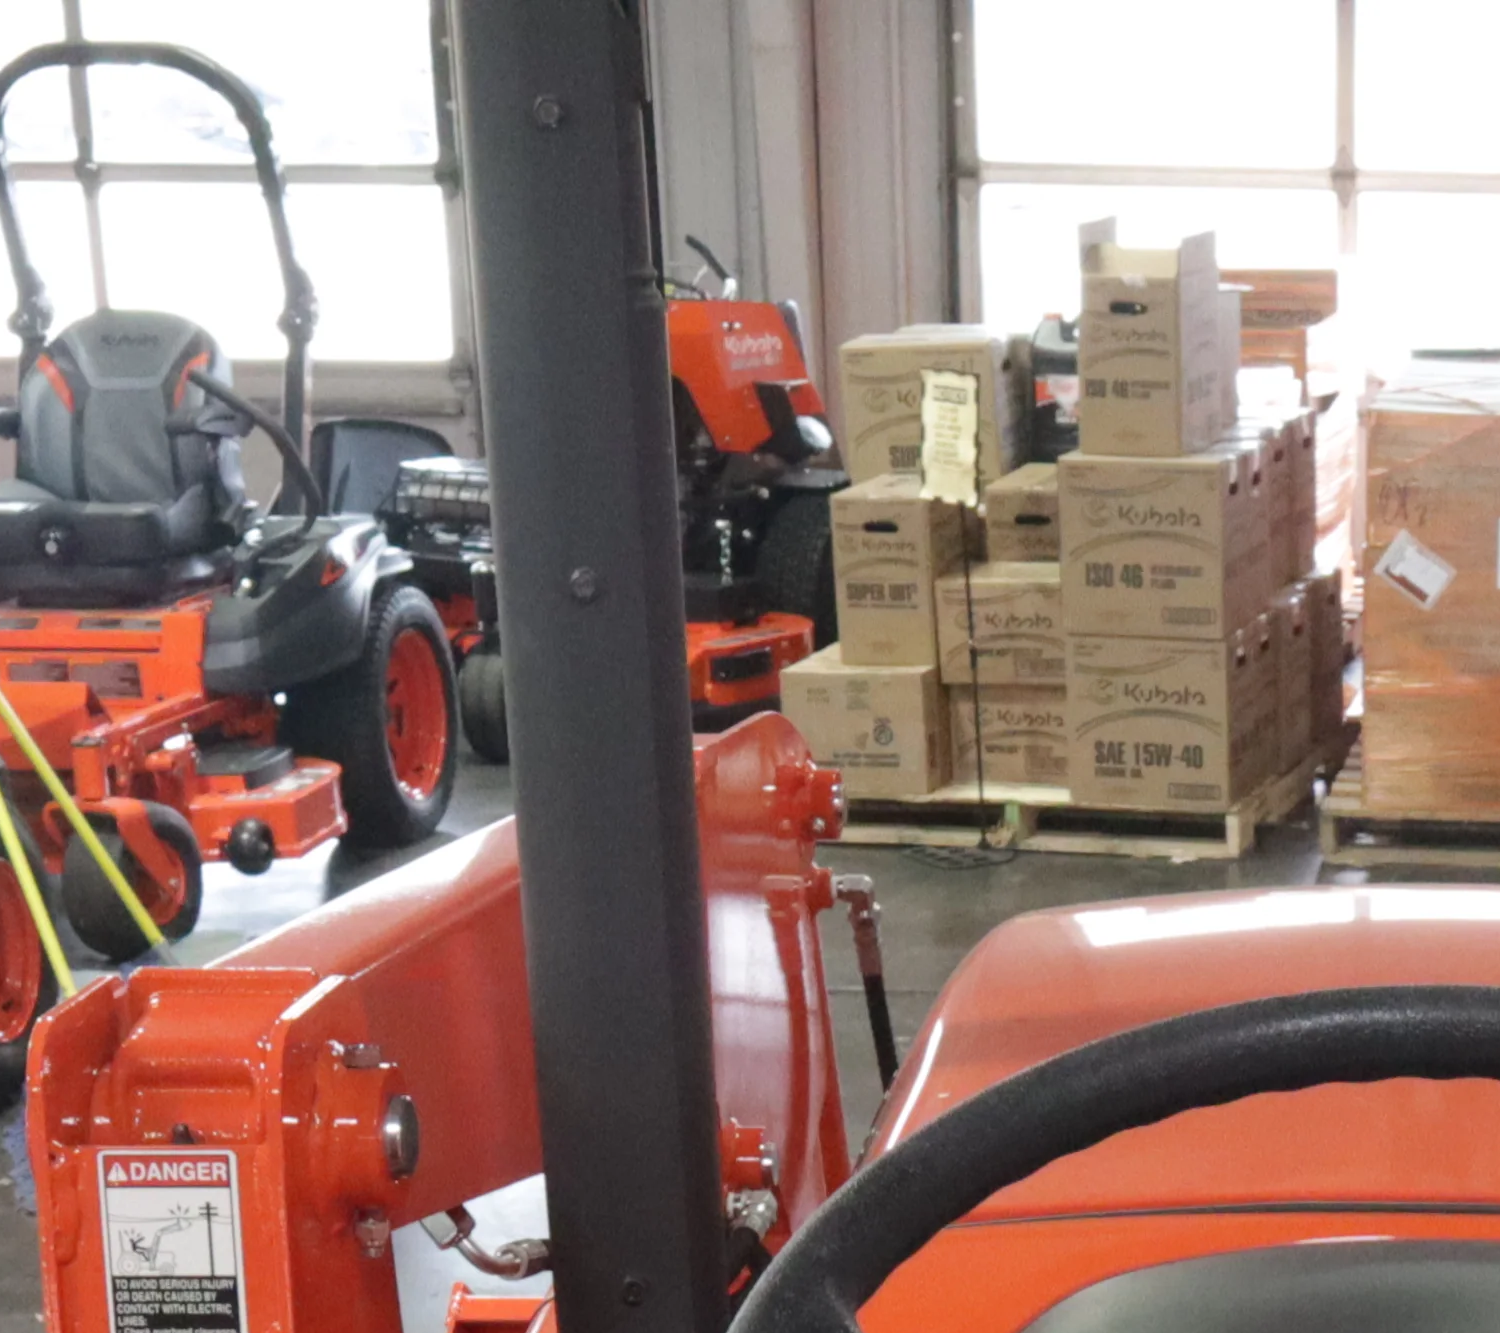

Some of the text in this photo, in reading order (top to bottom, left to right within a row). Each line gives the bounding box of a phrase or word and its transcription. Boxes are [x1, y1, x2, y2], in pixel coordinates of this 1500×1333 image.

[889, 444, 921, 468] SUP
[1118, 504, 1202, 528] Kubota
[1084, 562, 1114, 588] ISO
[1120, 563, 1143, 589] 46
[1124, 682, 1206, 706] Kubota
[1094, 740, 1203, 769] SAE 15W-40
[130, 1161, 228, 1182] DANGER
[115, 1279, 235, 1290] TO AVOID SERIOUS INJURY
[116, 1291, 217, 1302] OR DEATH CAUSED BY
[117, 1303, 232, 1315] CONTACT WITH ELECTRIC
[118, 1315, 147, 1327] LINES:
